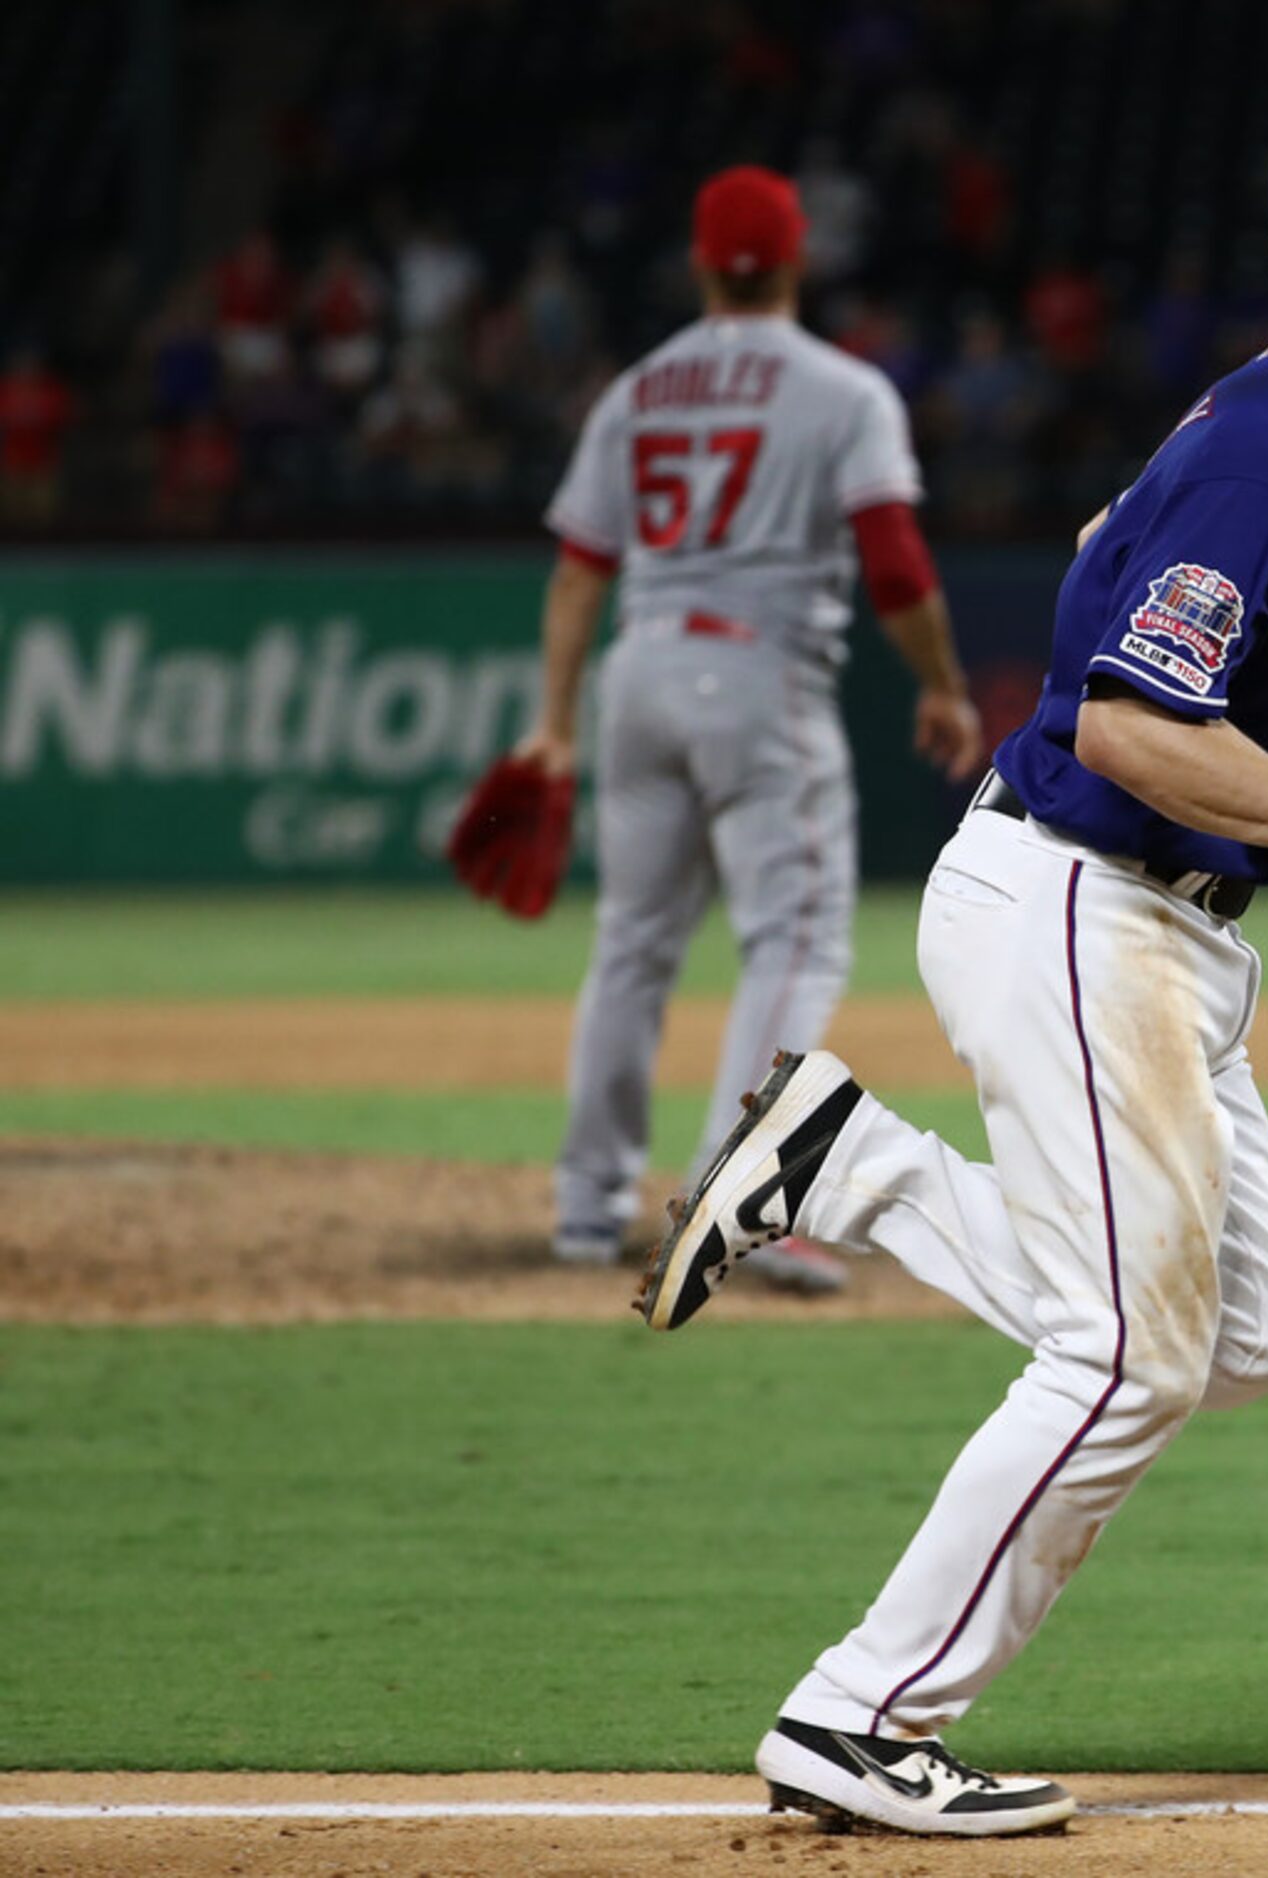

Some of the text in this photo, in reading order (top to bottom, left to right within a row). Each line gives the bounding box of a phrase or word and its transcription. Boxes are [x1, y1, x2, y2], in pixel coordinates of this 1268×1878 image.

[634, 425, 763, 549] 57
[1126, 638, 1163, 664] MLB
[1179, 625, 1217, 658] SEASON
[2, 616, 564, 776] Nation
